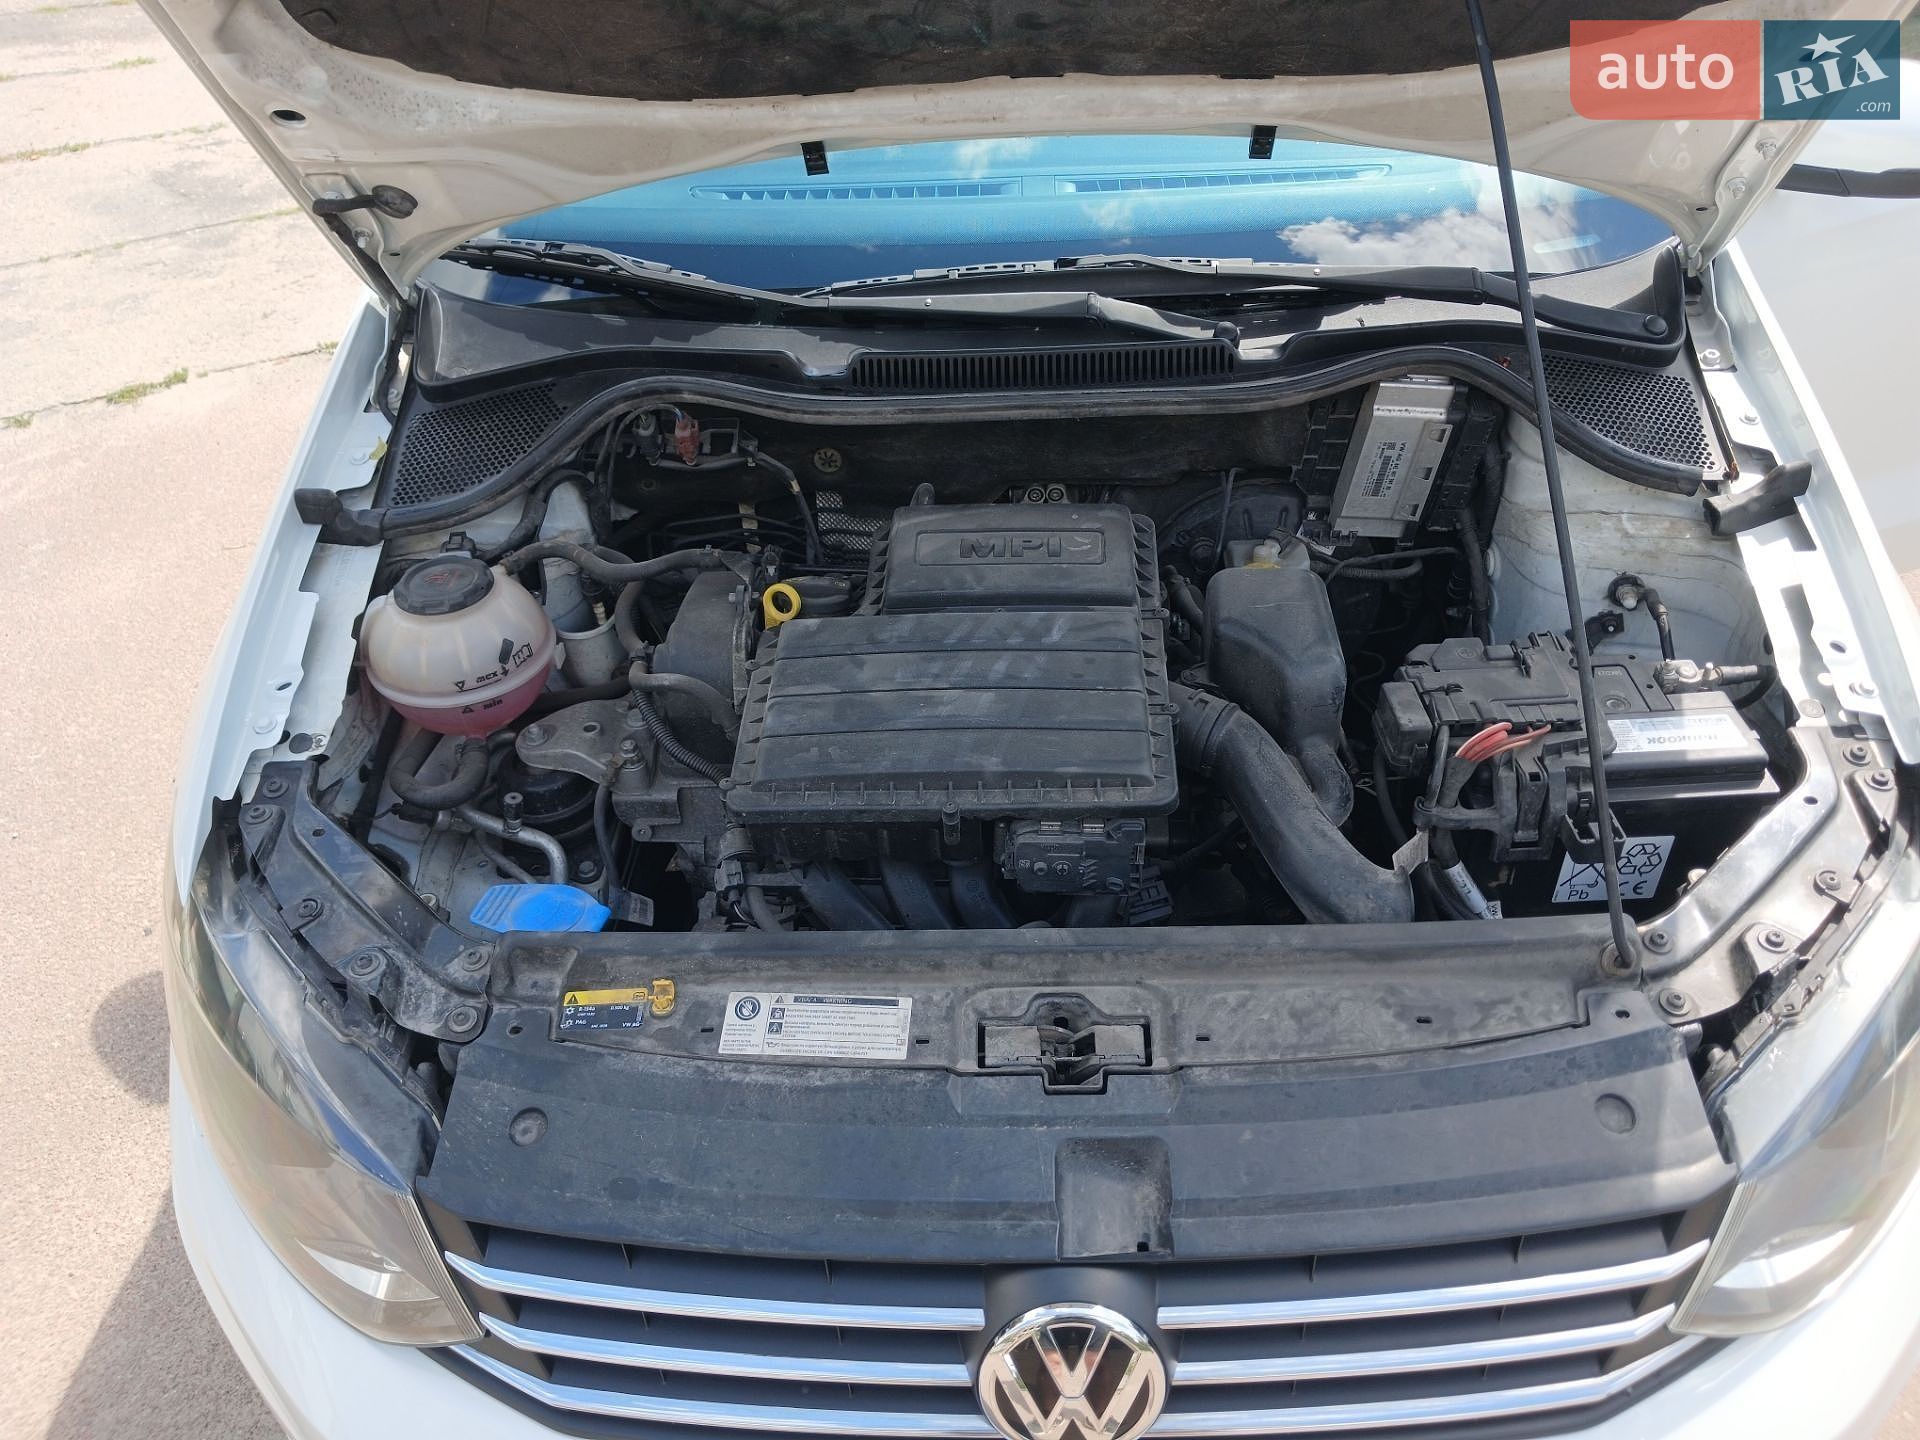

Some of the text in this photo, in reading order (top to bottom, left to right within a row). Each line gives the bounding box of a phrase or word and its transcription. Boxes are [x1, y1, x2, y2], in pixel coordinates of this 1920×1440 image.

[960, 536, 1062, 558] MPI
[483, 699, 503, 710] min
[1567, 889, 1589, 900] Pb
[989, 1315, 1156, 1440] VW
